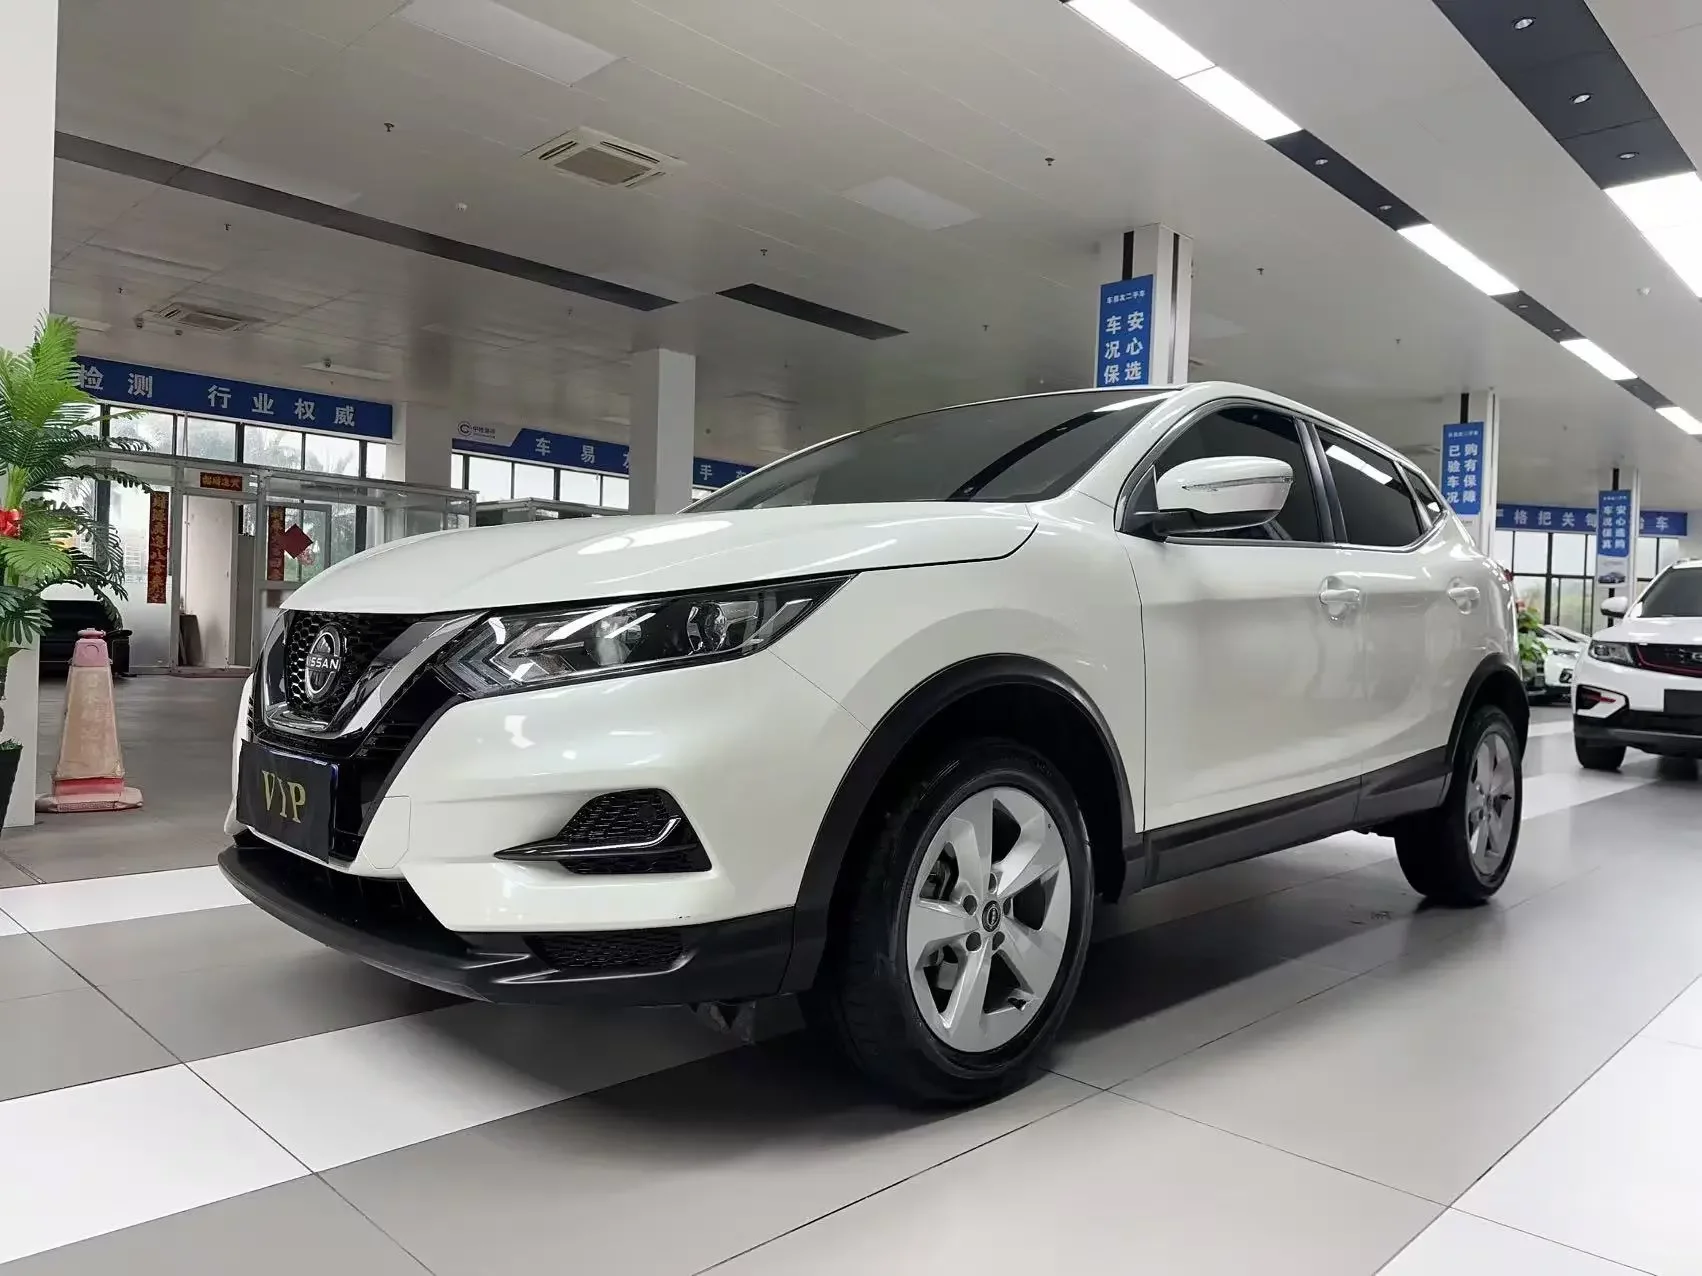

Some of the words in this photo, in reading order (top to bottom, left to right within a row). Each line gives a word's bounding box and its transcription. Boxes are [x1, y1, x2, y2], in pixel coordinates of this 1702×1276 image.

[79, 364, 153, 398] 检测
[207, 384, 356, 427] 行业权威
[261, 769, 306, 824] VIP
